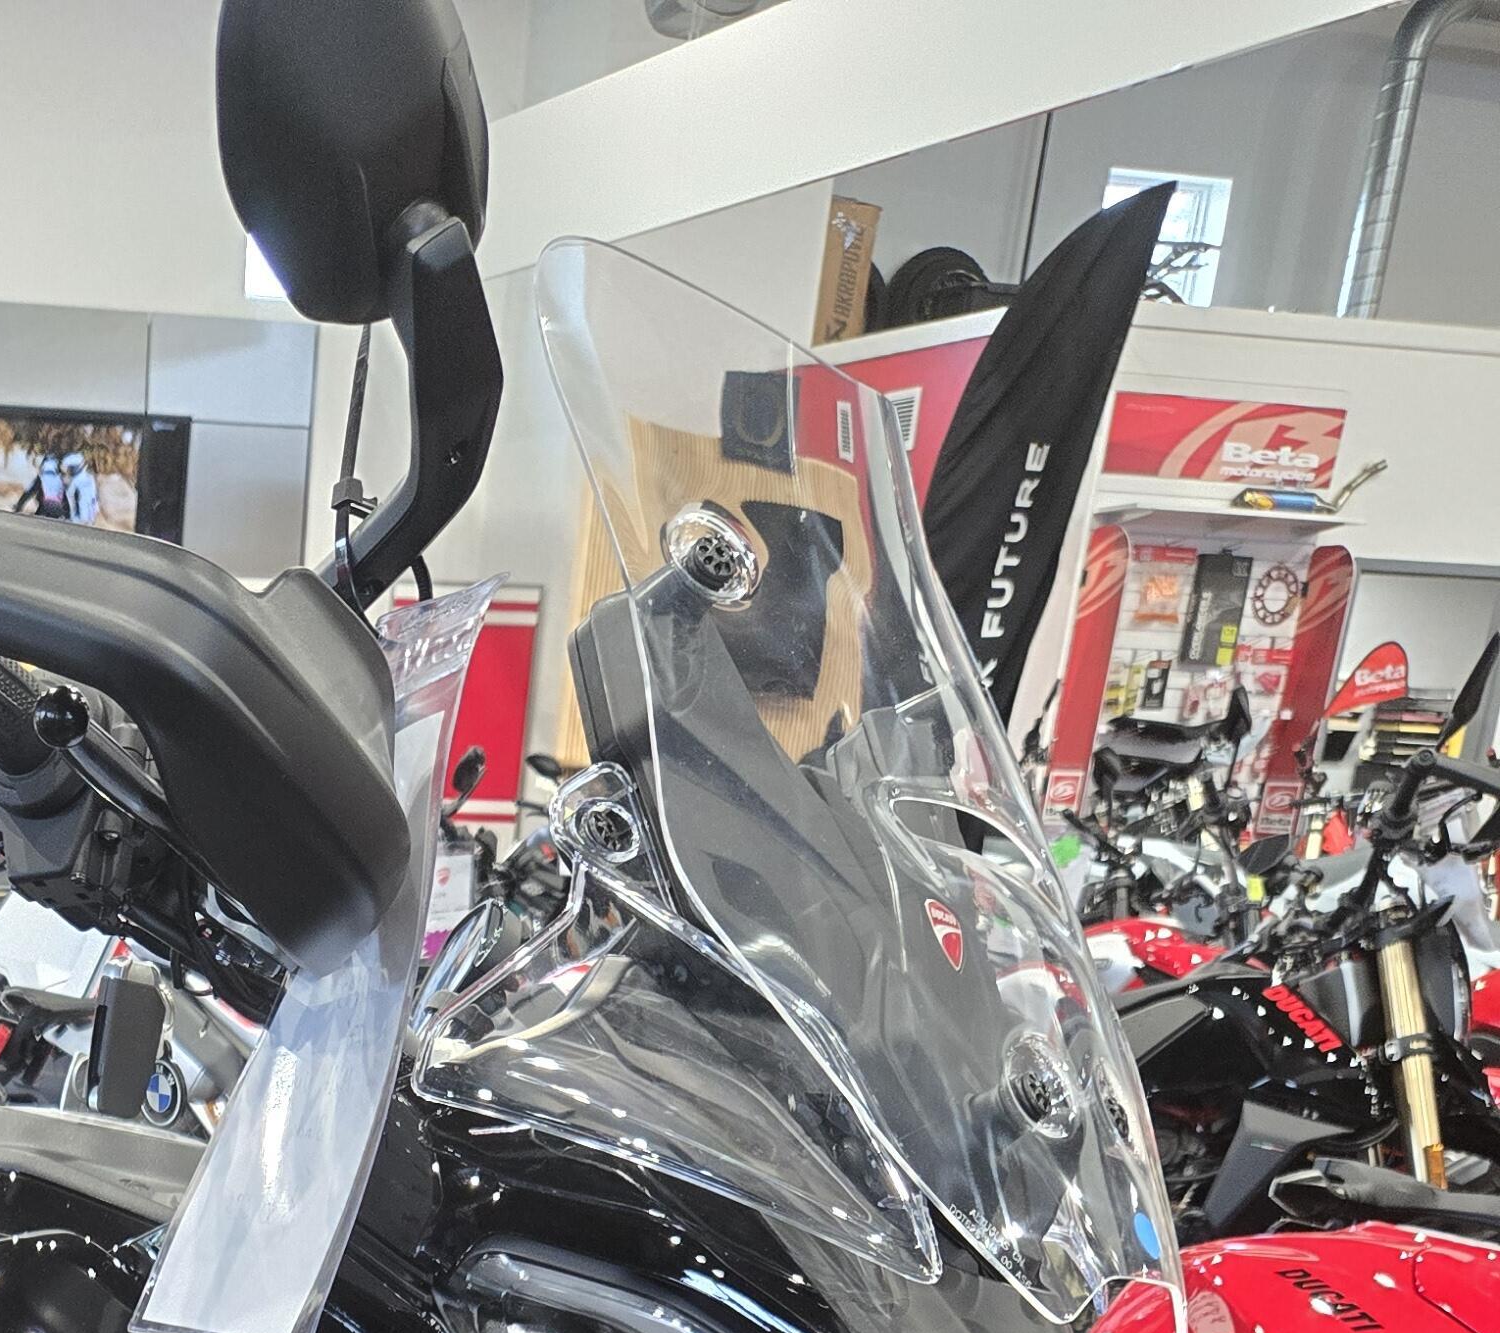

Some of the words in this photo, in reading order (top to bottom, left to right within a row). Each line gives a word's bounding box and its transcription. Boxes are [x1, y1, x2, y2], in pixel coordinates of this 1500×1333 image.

[1220, 442, 1320, 468] Beta
[980, 442, 1051, 638] FUTURE
[1261, 984, 1343, 1053] DUCATI
[1275, 1268, 1385, 1332] DUCATI
